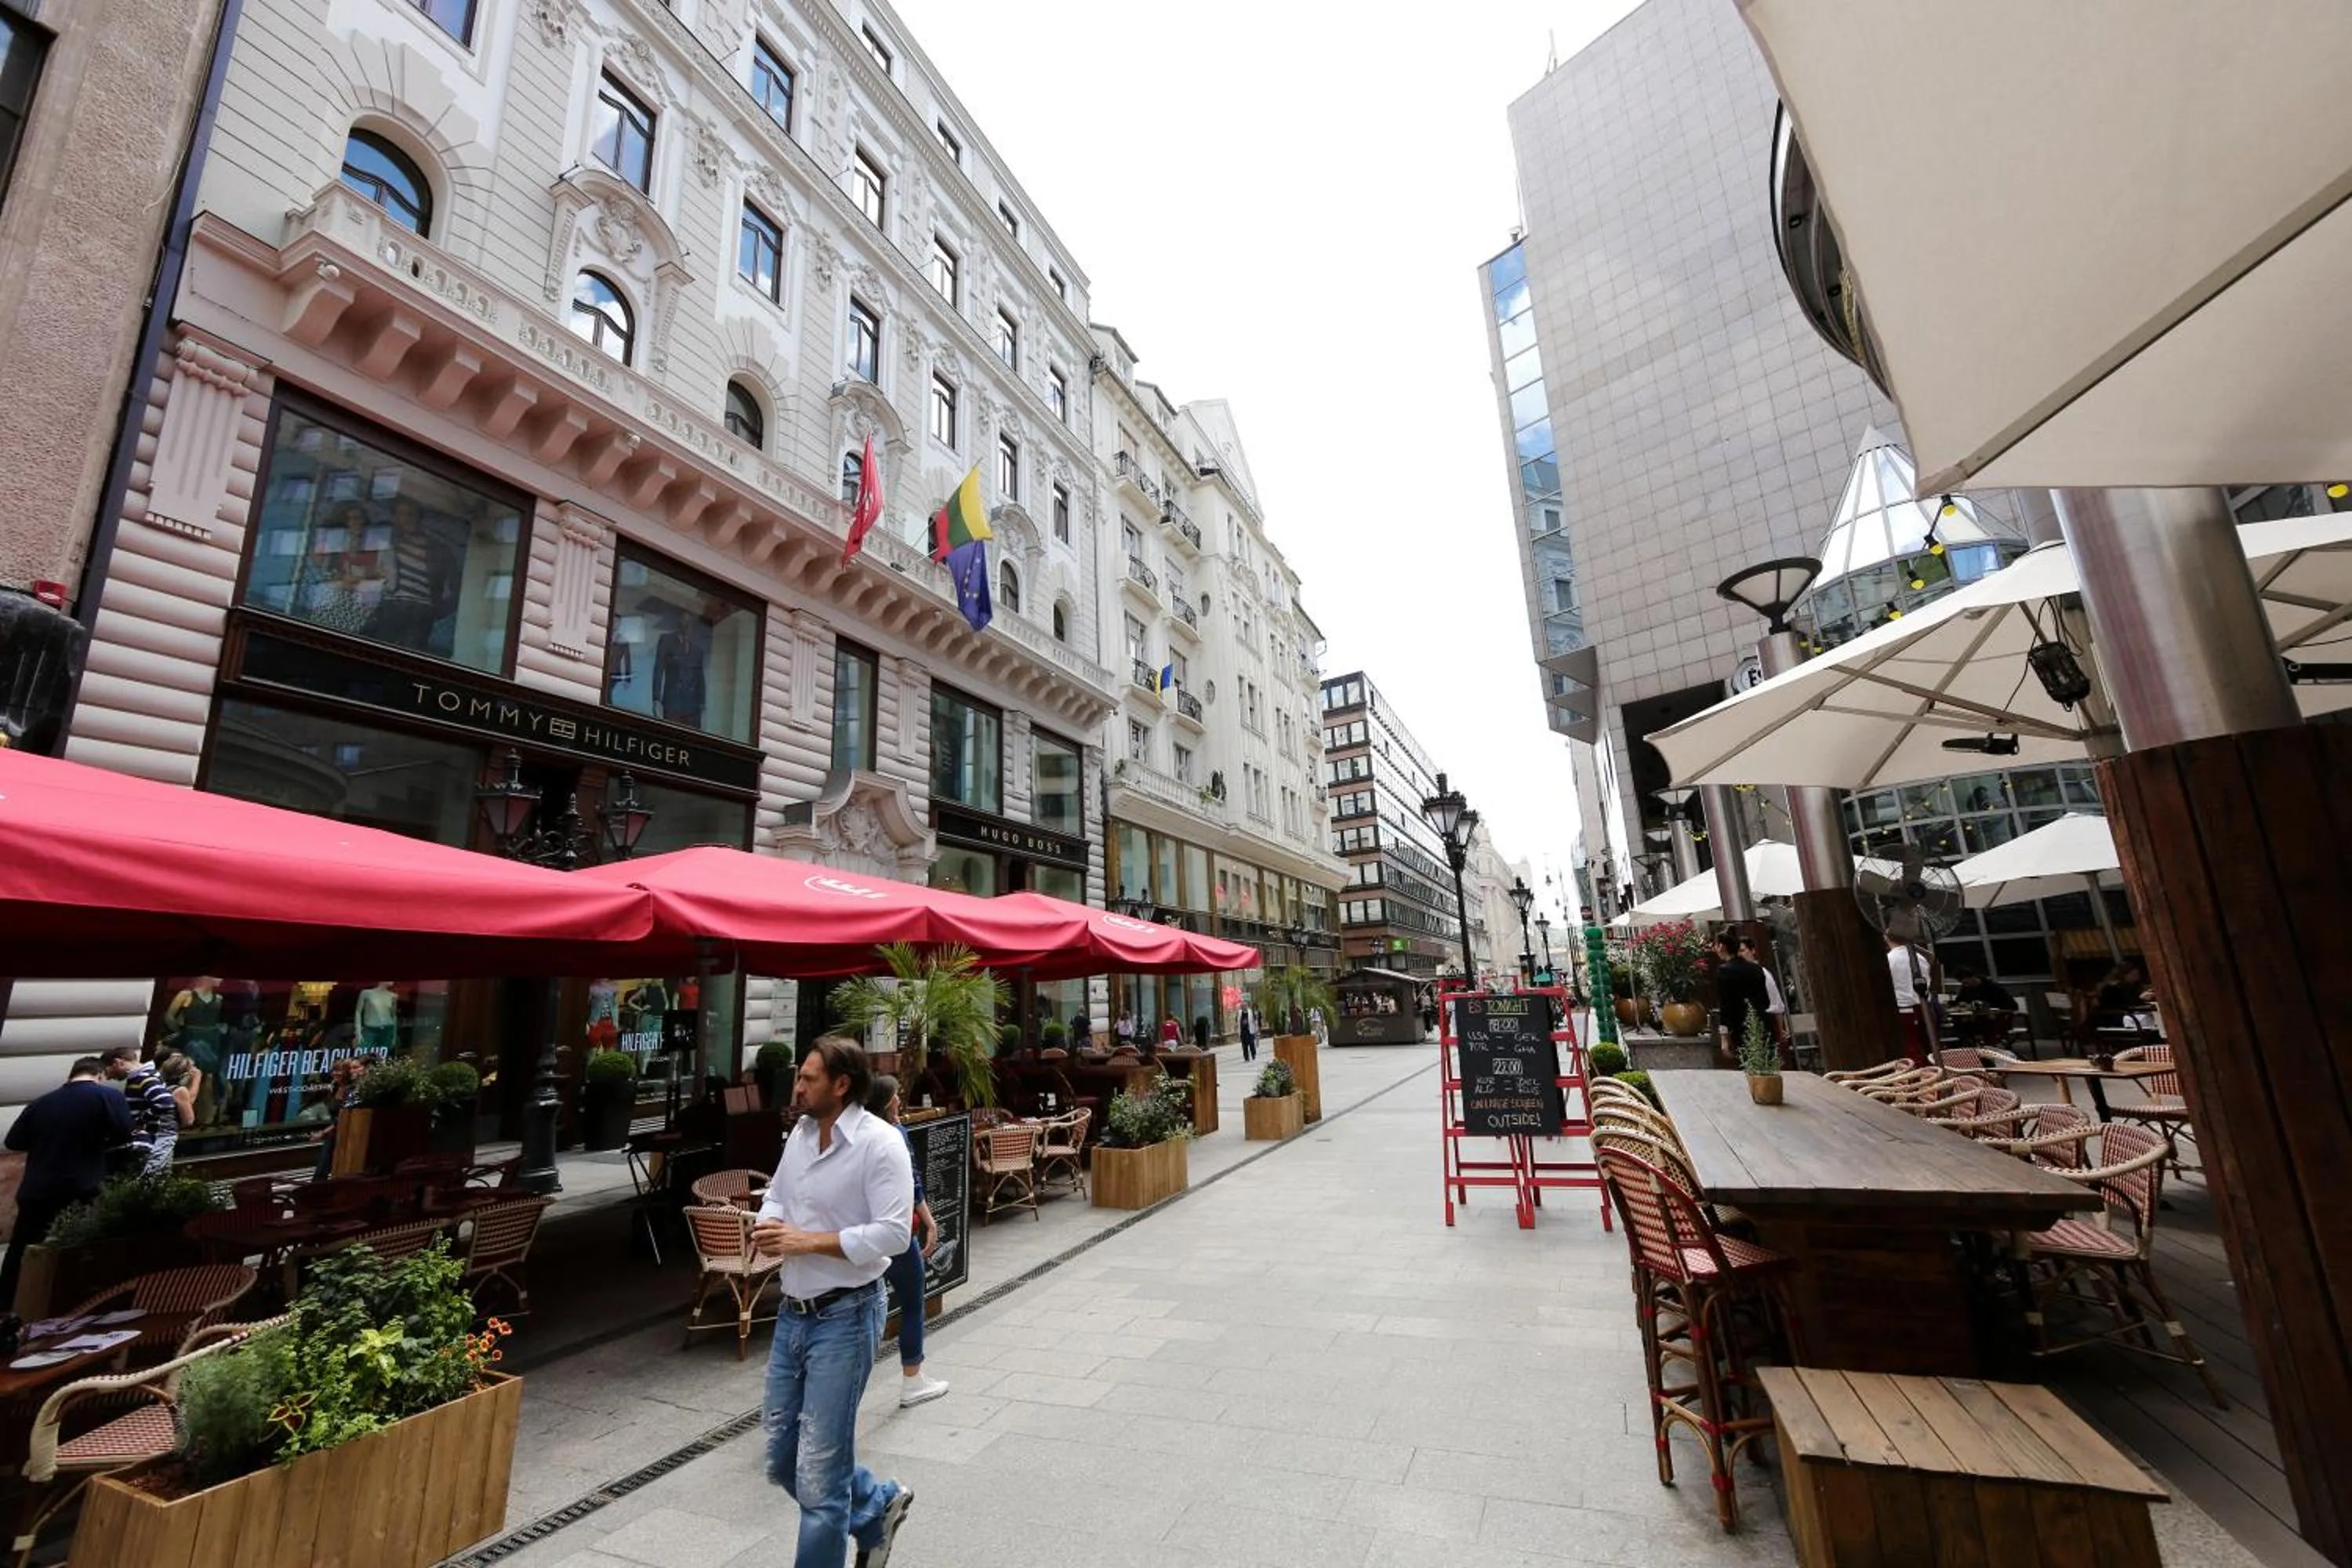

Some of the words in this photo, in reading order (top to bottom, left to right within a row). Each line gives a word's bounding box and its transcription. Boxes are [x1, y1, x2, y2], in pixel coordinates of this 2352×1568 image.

[1748, 667, 1762, 688] É
[413, 683, 543, 731] TOMMY
[584, 726, 691, 767] HILFIGER
[981, 825, 1019, 844] HUGO
[1028, 837, 1061, 854] BOSS
[227, 1048, 298, 1080] HILFIGER
[1487, 1112, 1542, 1128] OUTSIDE!
